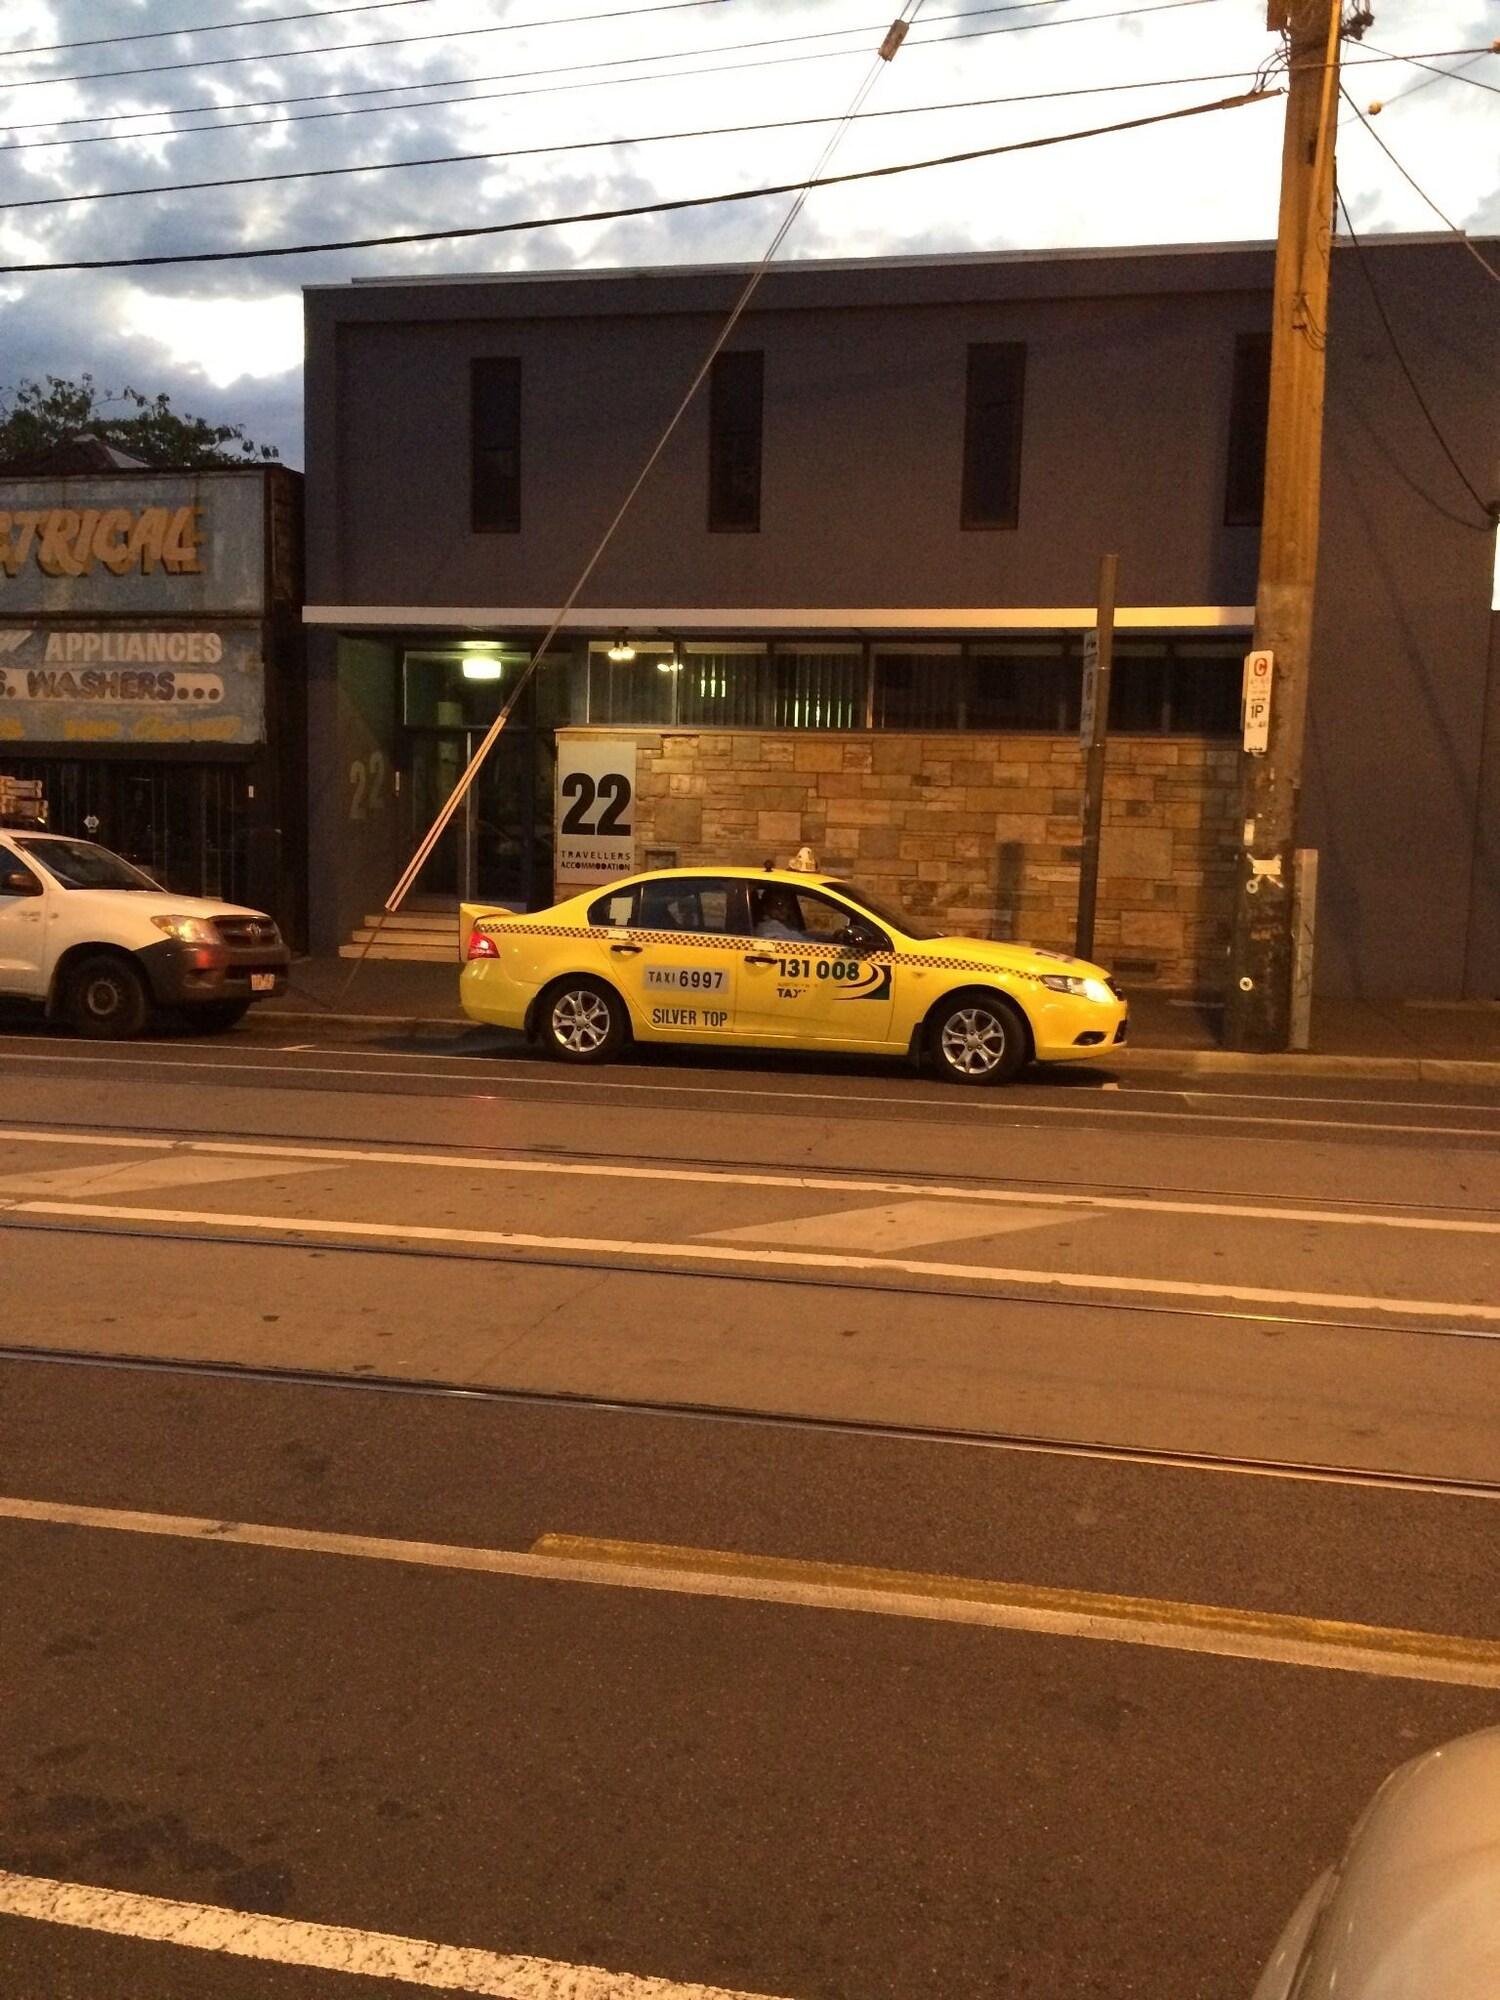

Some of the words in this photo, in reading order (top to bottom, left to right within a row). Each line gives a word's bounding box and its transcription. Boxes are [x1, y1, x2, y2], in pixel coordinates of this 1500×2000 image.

[45, 633, 222, 662] APPLIANCES
[562, 773, 631, 836] 22
[560, 850, 631, 860] TRAVELLERS
[561, 861, 630, 871] ACCOMMODATION
[648, 971, 675, 983] TAXI
[680, 970, 723, 988] 6997
[779, 958, 810, 978] 131
[816, 960, 860, 981] 008
[653, 1008, 697, 1025] SILVER
[702, 1010, 728, 1027] TOP
